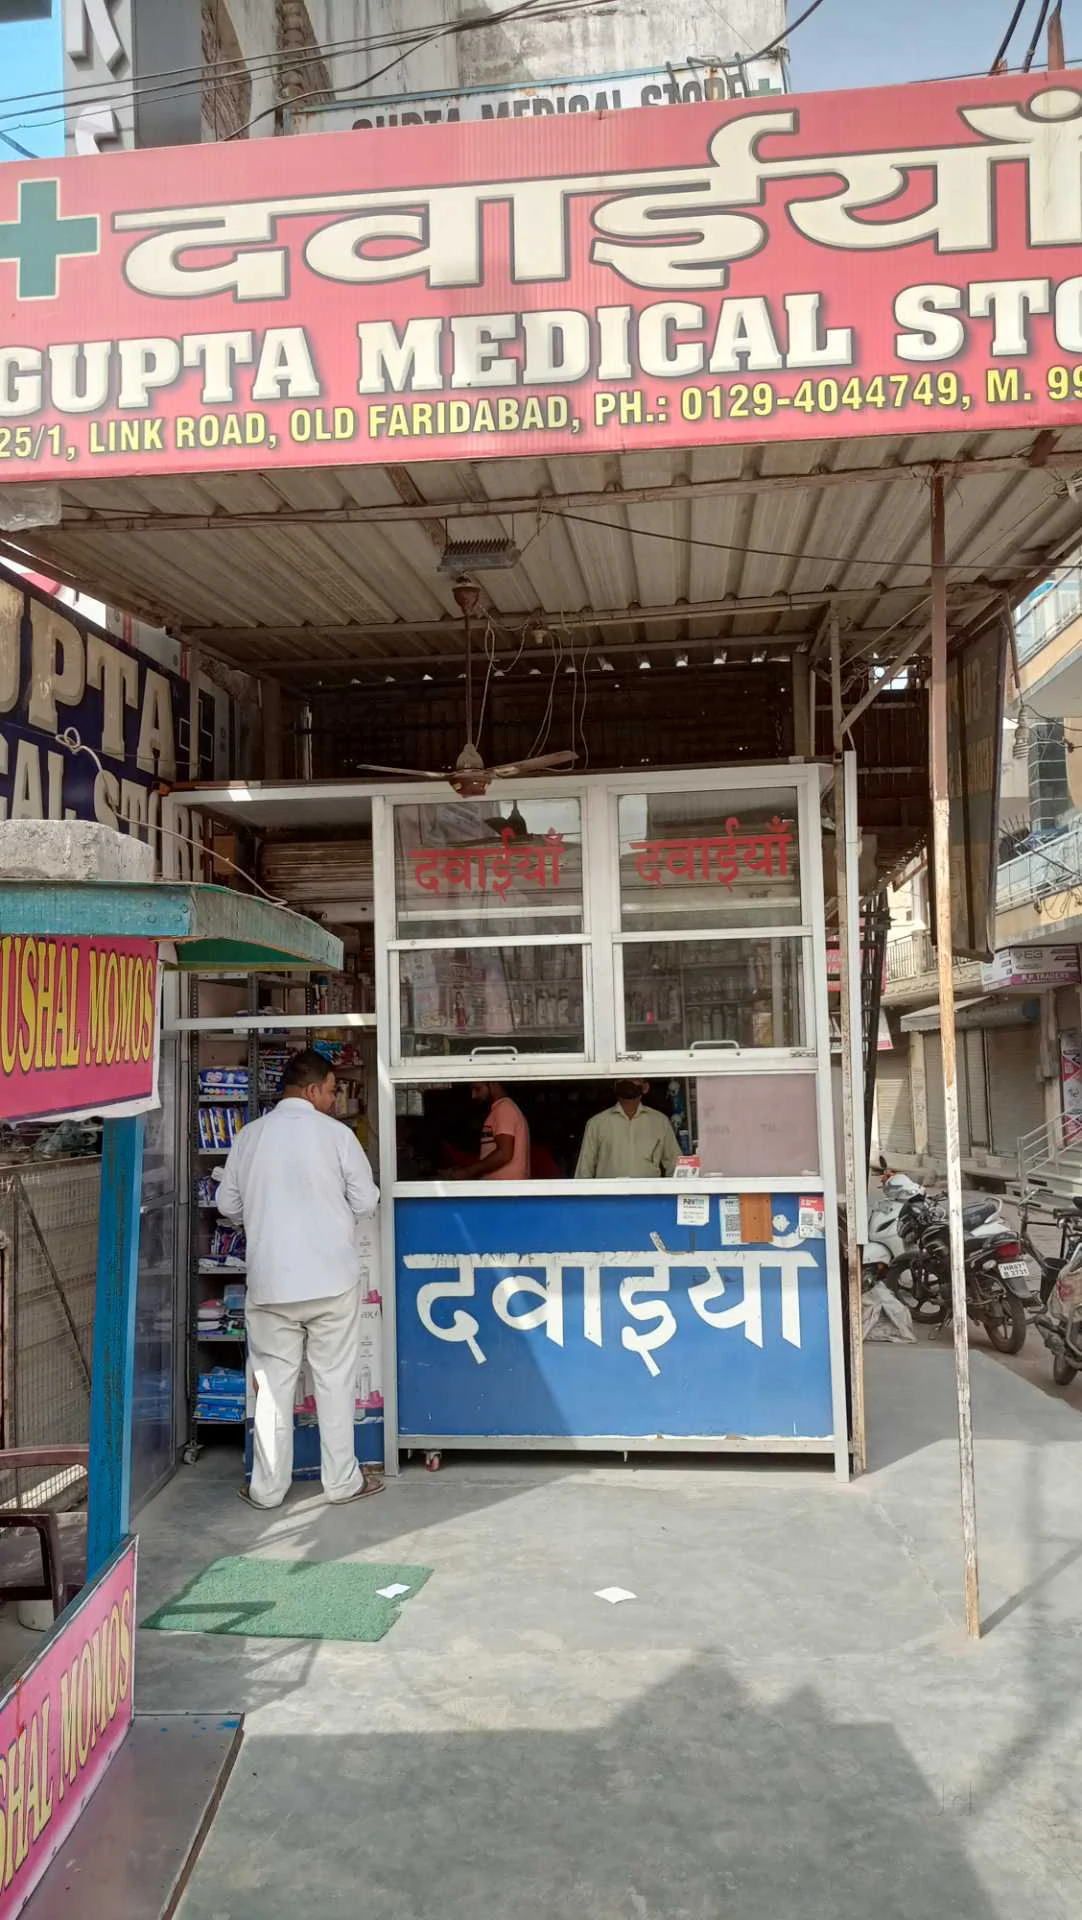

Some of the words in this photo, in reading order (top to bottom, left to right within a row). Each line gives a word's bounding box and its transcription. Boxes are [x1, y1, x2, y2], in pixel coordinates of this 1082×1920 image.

[0, 326, 320, 417] GUPTA
[356, 293, 854, 394] MEDICAL
[90, 417, 164, 453] LINK
[176, 412, 277, 448] ROAD,
[290, 407, 354, 443] OLD
[369, 394, 580, 438] FARIDABAD,
[595, 389, 668, 427] PH.:
[681, 371, 972, 421] 0129-4044749,
[987, 368, 1032, 402] M.
[0, 732, 76, 821] AL
[1, 936, 80, 1075] USHAL
[85, 949, 155, 1065] MOMOS
[59, 1586, 131, 1801] MOMOS
